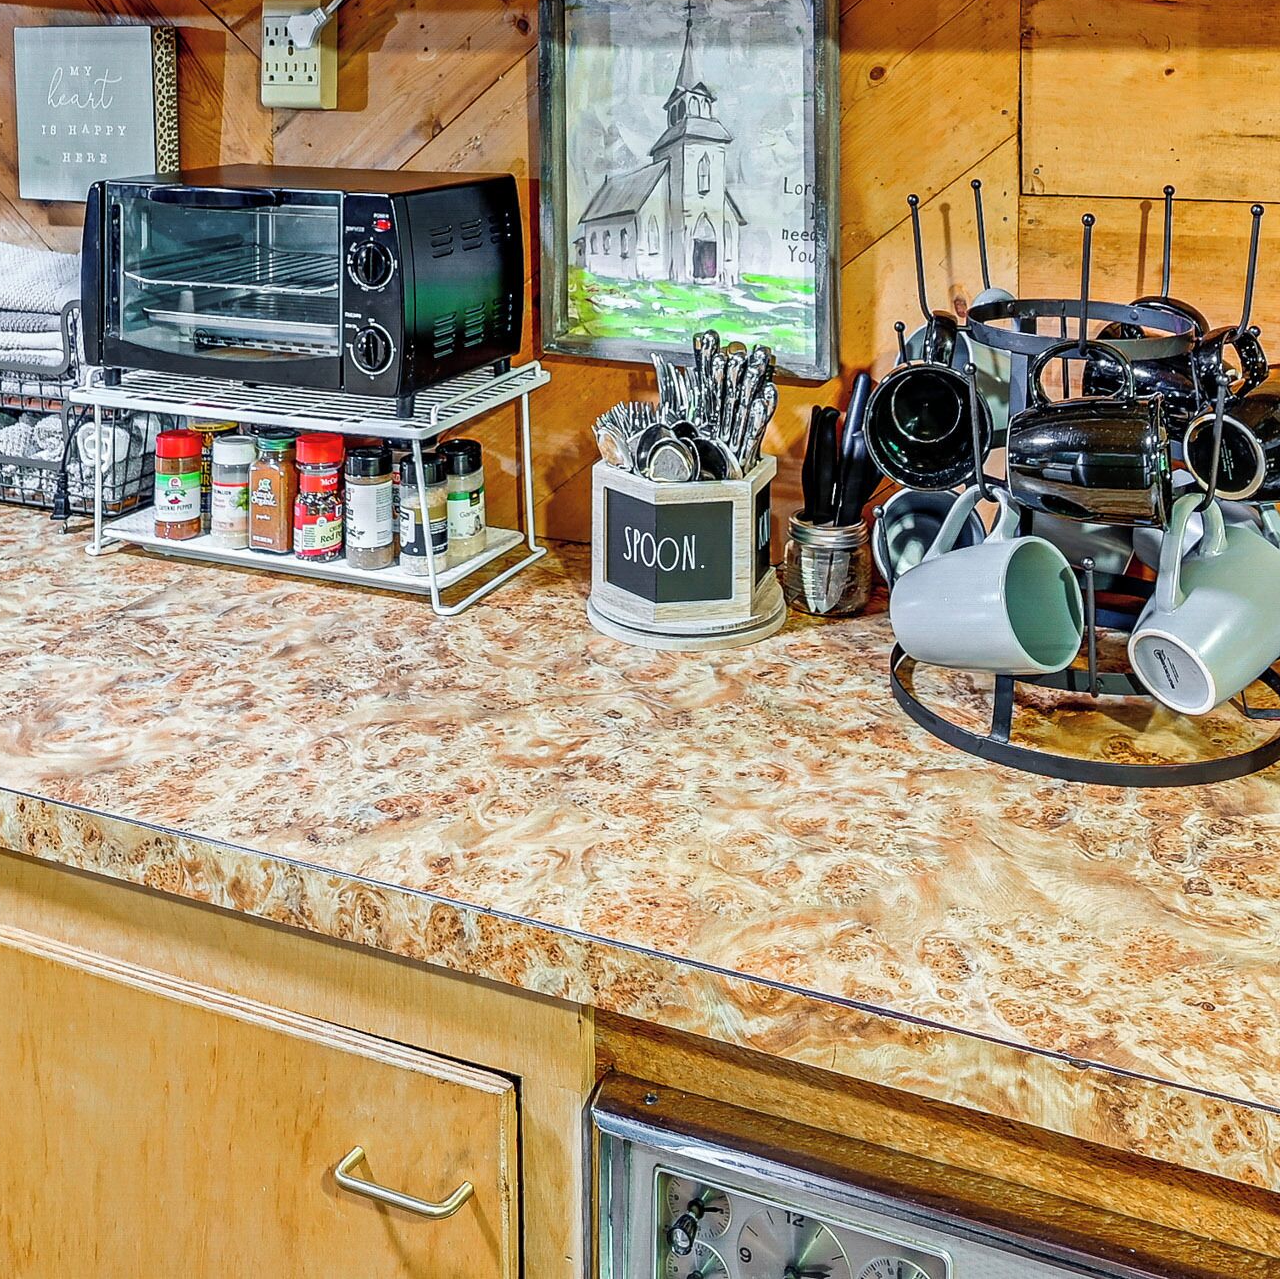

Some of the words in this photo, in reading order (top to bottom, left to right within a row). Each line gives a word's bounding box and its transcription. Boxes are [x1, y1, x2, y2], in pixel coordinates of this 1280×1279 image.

[70, 66, 92, 76] MY
[47, 66, 122, 109] heart
[41, 125, 57, 135] IS
[68, 124, 128, 136] HAPPY
[62, 152, 109, 164] HERE
[784, 1210, 805, 1228] 12
[739, 1246, 753, 1264] 9
